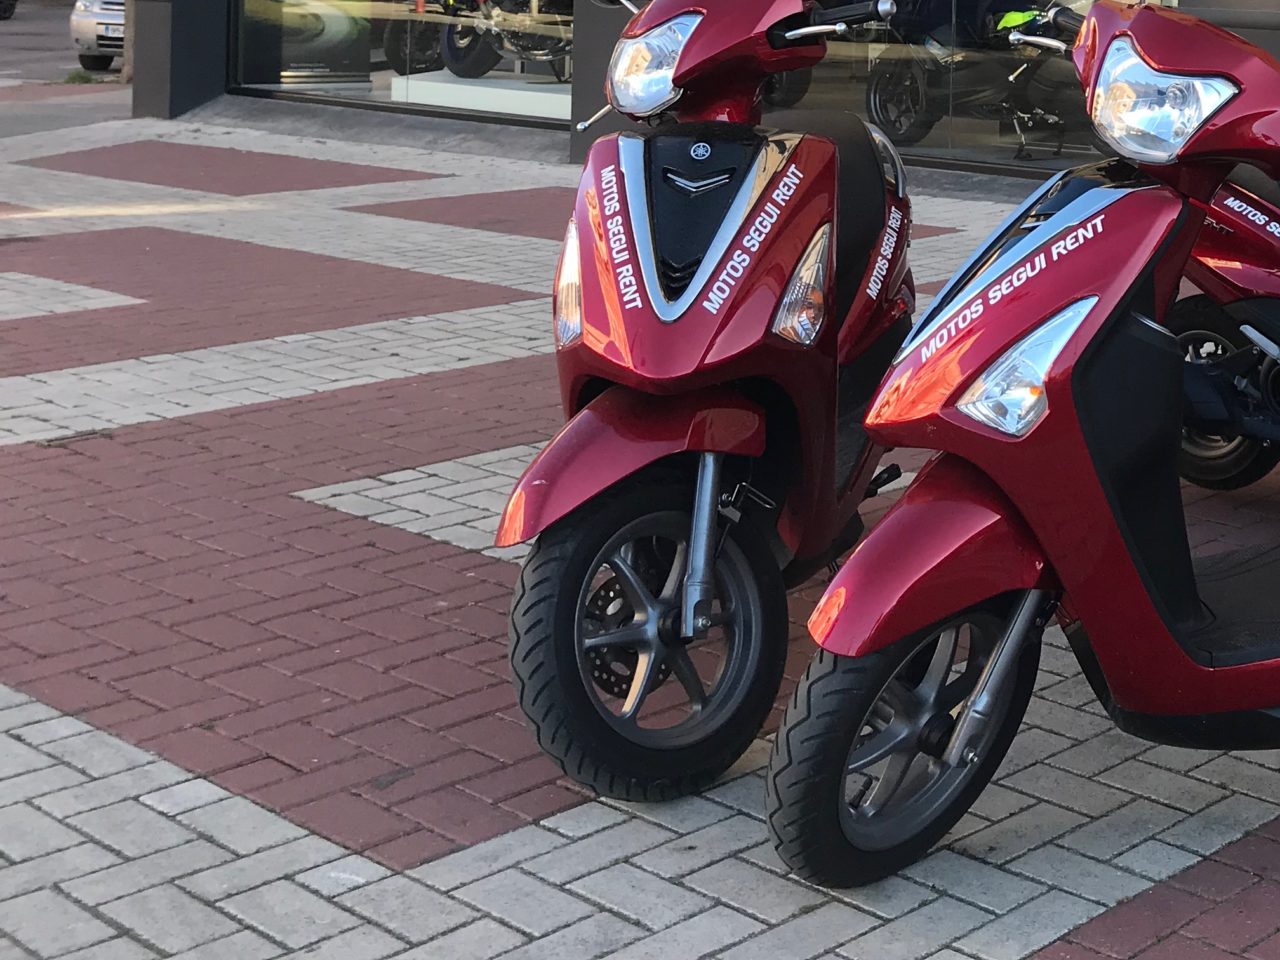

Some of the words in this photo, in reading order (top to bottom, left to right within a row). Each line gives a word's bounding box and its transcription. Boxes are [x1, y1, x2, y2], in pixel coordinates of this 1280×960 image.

[601, 164, 620, 216] MOTOS
[1223, 196, 1269, 226] MOTOS
[607, 215, 630, 264] SEGUI
[703, 249, 751, 316] MOTOS
[745, 202, 780, 252] SEGUI
[771, 163, 806, 206] RENT
[888, 205, 903, 232] RENT
[880, 227, 898, 259] SEGUI
[616, 263, 643, 310] RENT
[866, 256, 889, 300] MOTOS
[920, 300, 984, 363] MOTOS
[988, 254, 1047, 305] SEGUI
[1051, 214, 1106, 262] RENT
